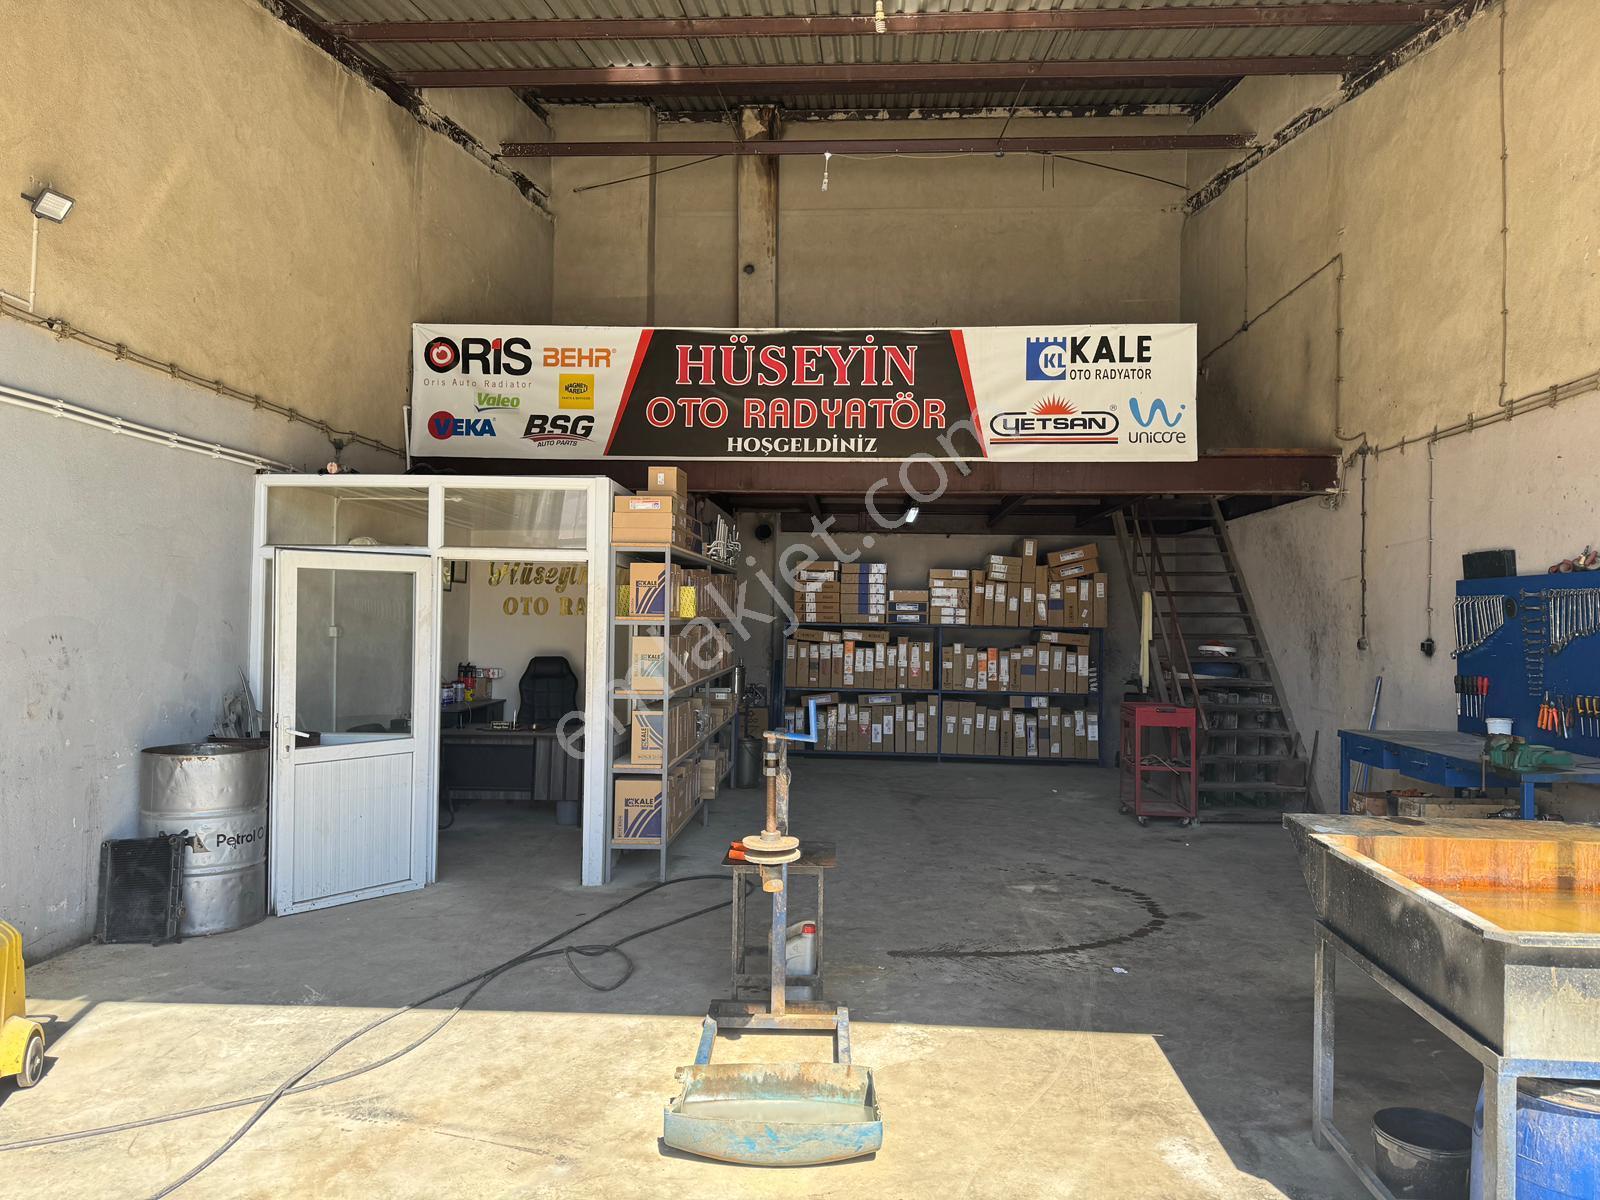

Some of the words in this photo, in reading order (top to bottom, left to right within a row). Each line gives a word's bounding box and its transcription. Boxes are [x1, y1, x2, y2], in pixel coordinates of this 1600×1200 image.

[543, 347, 612, 368] BEHR
[1070, 335, 1152, 363] KALE
[675, 334, 918, 386] HÜSEYİN
[1043, 353, 1066, 369] KL
[1069, 368, 1091, 380] OTO
[1095, 366, 1152, 380] RADYATÖR
[423, 378, 446, 387] Oris
[452, 378, 477, 388] Auto
[484, 379, 532, 389] Radiator
[477, 392, 520, 408] Valeo
[646, 397, 729, 429] OTO
[743, 392, 947, 430] RADYATÖR
[434, 418, 497, 437] VEKA
[523, 414, 595, 438] BSG
[1002, 417, 1107, 434] YETSAN
[537, 440, 555, 448] AUTO
[727, 434, 878, 456] HOŞGELDİNİZ
[503, 596, 549, 616] OTO
[635, 797, 654, 805] KALE
[216, 829, 256, 847] Petrol
